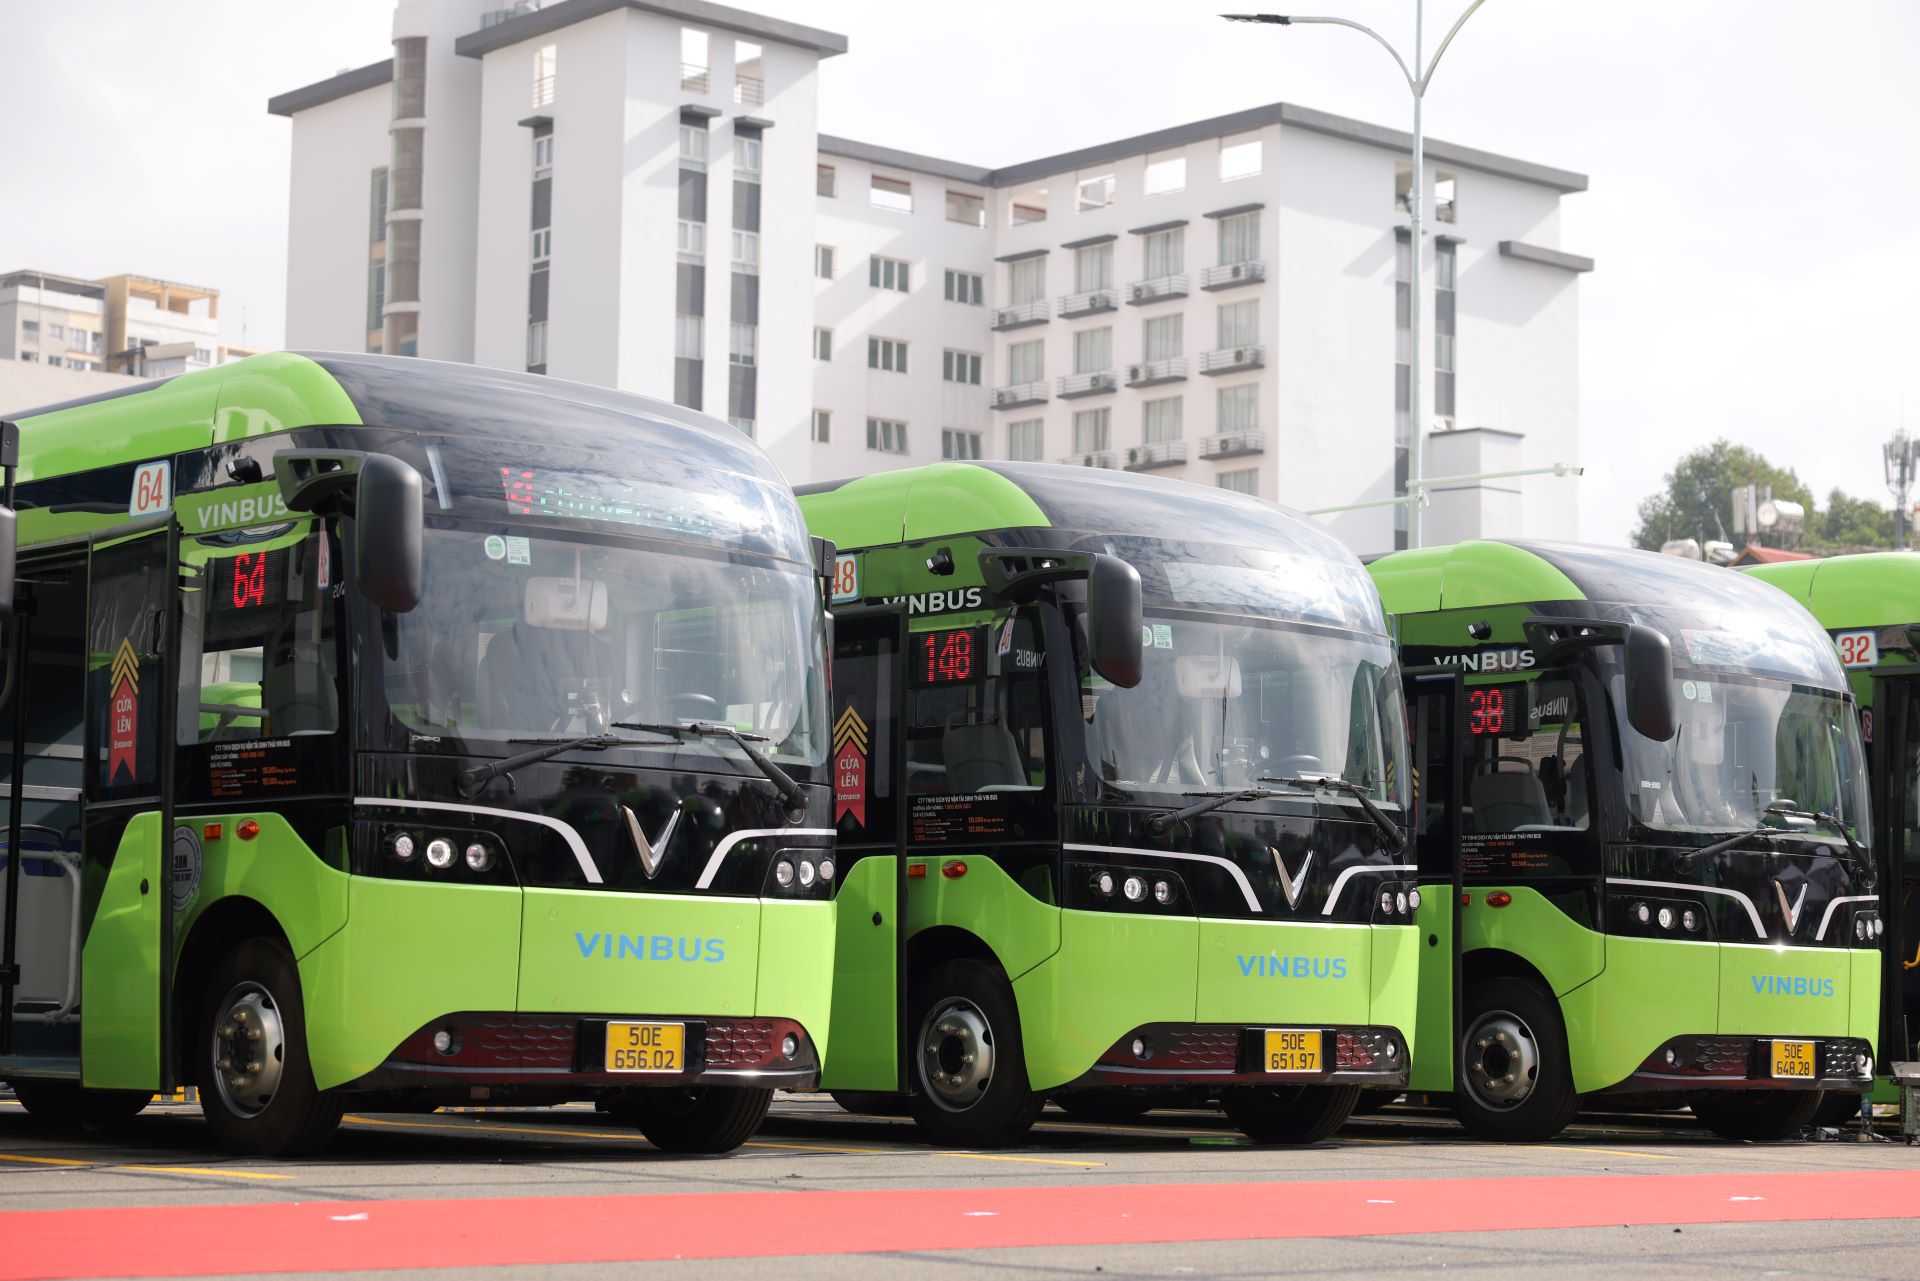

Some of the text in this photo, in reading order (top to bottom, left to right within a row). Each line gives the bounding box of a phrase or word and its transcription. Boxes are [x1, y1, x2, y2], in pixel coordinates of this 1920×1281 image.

[138, 468, 163, 511] 64
[197, 494, 289, 529] VINBUS
[233, 550, 266, 608] 64
[823, 560, 855, 595] 48
[924, 631, 970, 682] 148
[1841, 635, 1870, 665] 32
[1470, 690, 1503, 734] 38
[117, 715, 131, 733] LÊN
[840, 754, 860, 770] CỬA
[841, 772, 859, 787] LÊN
[837, 793, 861, 801] Entrance
[575, 931, 726, 963] VINBUS
[1236, 953, 1347, 979] VINBUS
[1751, 975, 1835, 997] VINBUS
[629, 1027, 662, 1047] 50E
[1281, 1033, 1306, 1050] 50E
[614, 1050, 675, 1069] 656.02
[1271, 1053, 1316, 1070] 651.97
[1784, 1044, 1803, 1059] 50E
[1776, 1061, 1810, 1076] 648.28
